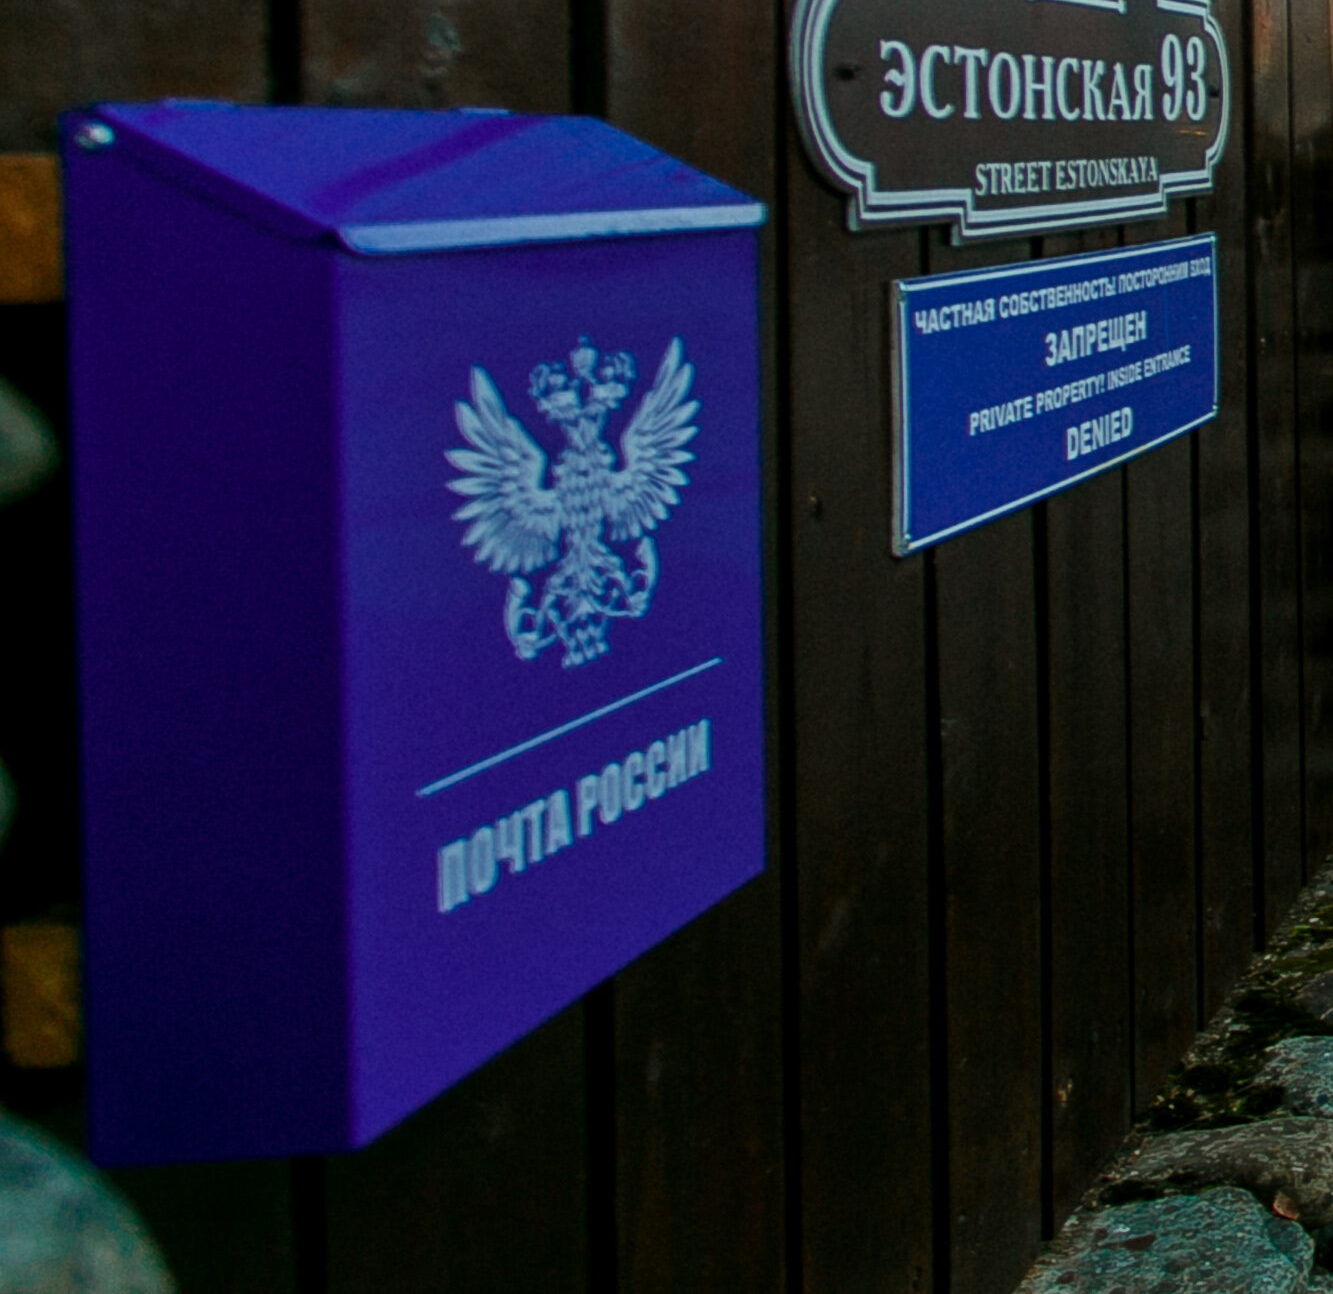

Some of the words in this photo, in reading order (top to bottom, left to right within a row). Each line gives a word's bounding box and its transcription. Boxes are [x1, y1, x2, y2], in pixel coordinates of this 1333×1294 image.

[879, 39, 1155, 121] ЭСТОНСКАЯ
[1160, 33, 1207, 122] 93
[974, 162, 1052, 196] STREET
[1055, 156, 1159, 191] ESTONSKAYA
[915, 298, 996, 334] ЧАСТНАЯ
[1118, 261, 1189, 294] ПОСТОРОННИМ
[1045, 310, 1148, 367] ЗАПРЕЩЕН
[969, 395, 1034, 437] PRIVATE
[1035, 373, 1105, 415] PROPERTY!
[1107, 362, 1143, 392] INSIDE
[1143, 345, 1192, 381] ENTRANCE
[1066, 407, 1134, 461] DENIED
[437, 789, 575, 914] ПОЧТА
[576, 718, 711, 837] РОССИИ
